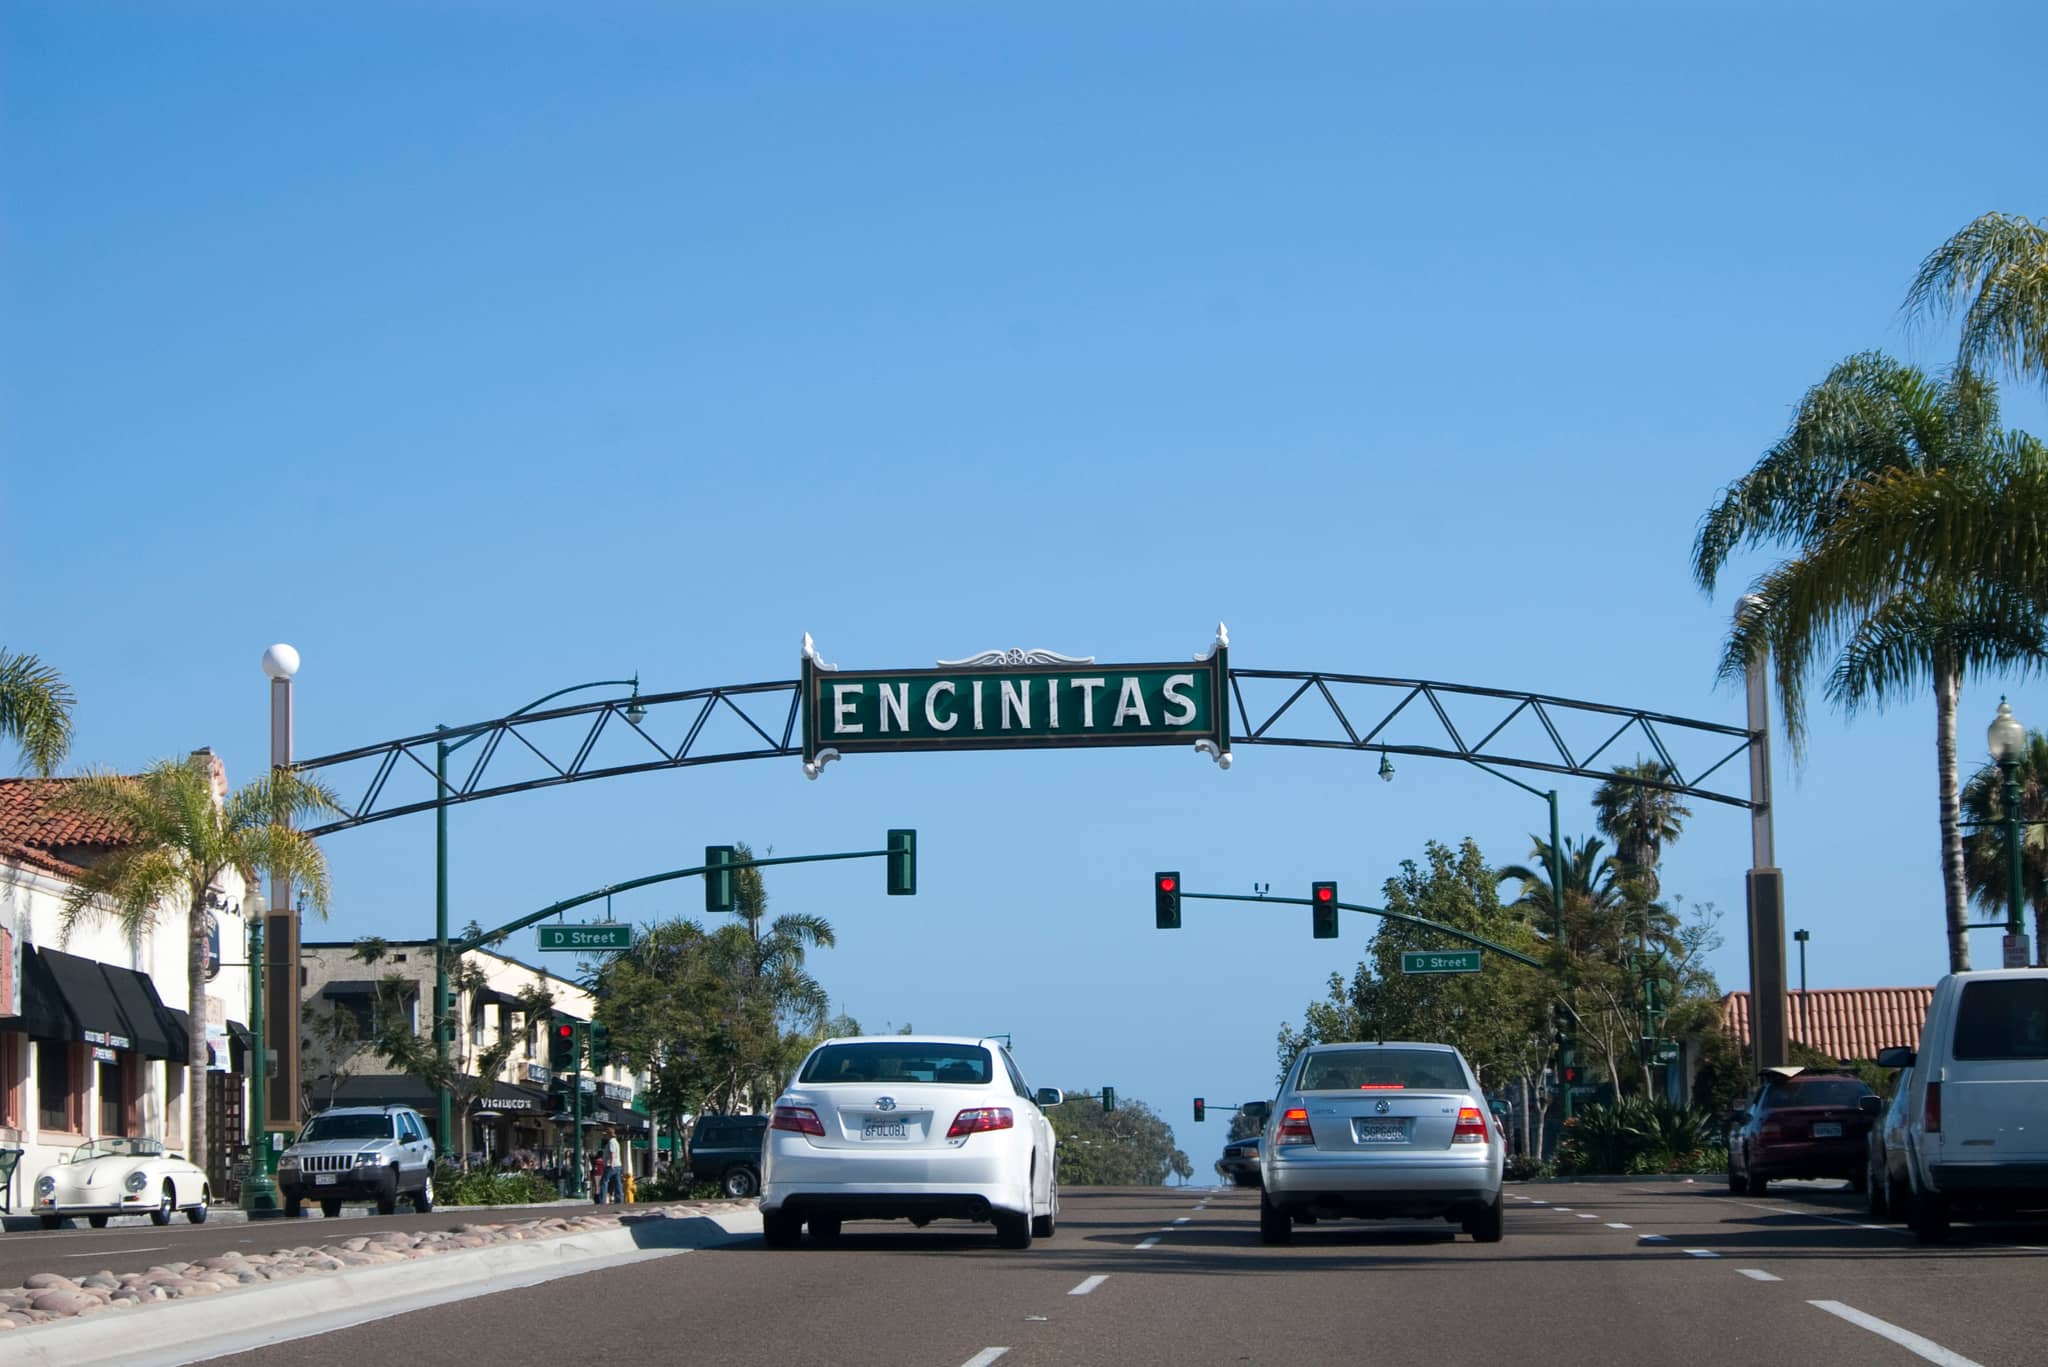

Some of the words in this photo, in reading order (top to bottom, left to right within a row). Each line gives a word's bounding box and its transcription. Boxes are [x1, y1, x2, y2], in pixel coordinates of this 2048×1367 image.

[832, 674, 1197, 734] ENCINITAS
[554, 932, 564, 944] D
[571, 931, 616, 944] Street
[1416, 958, 1424, 969] D
[1431, 957, 1467, 969] Street
